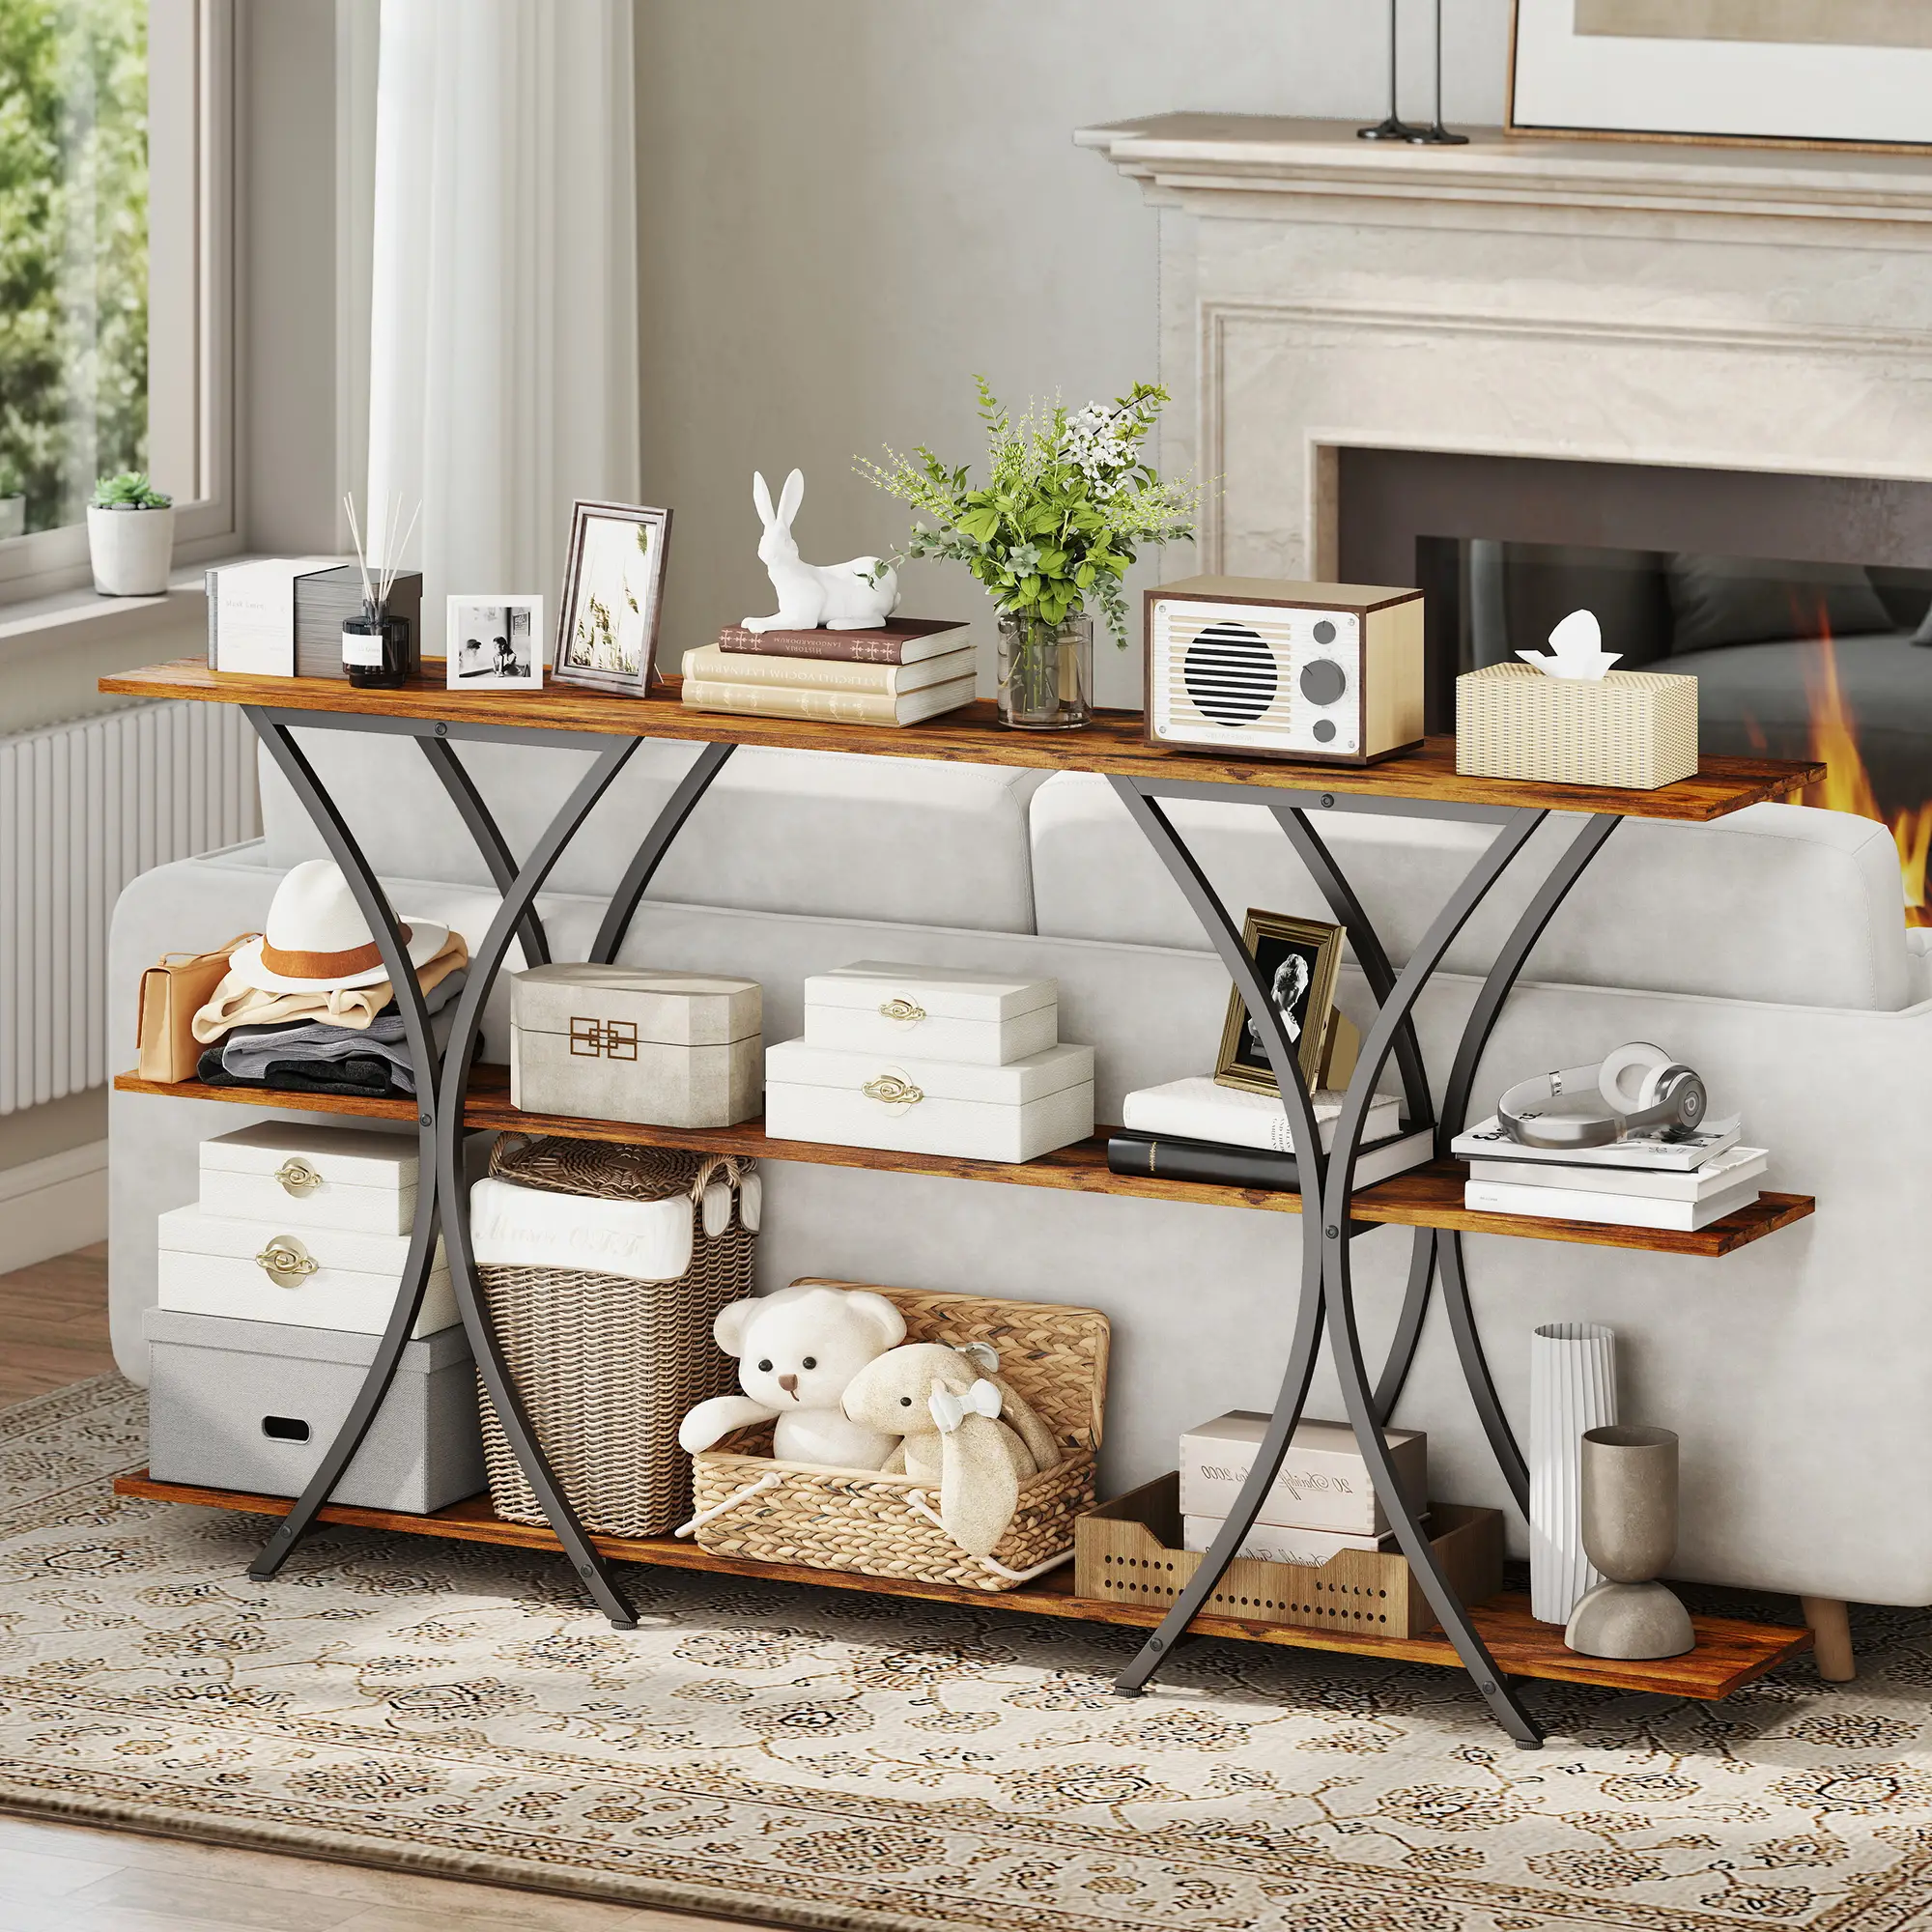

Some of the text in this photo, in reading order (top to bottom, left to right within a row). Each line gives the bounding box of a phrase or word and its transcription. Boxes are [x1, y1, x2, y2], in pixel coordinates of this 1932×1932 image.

[774, 637, 841, 648] LANGOBARDORUM
[784, 644, 822, 655] HISTORIA
[696, 663, 765, 678] LATINARUM
[770, 668, 815, 681] VOCUM
